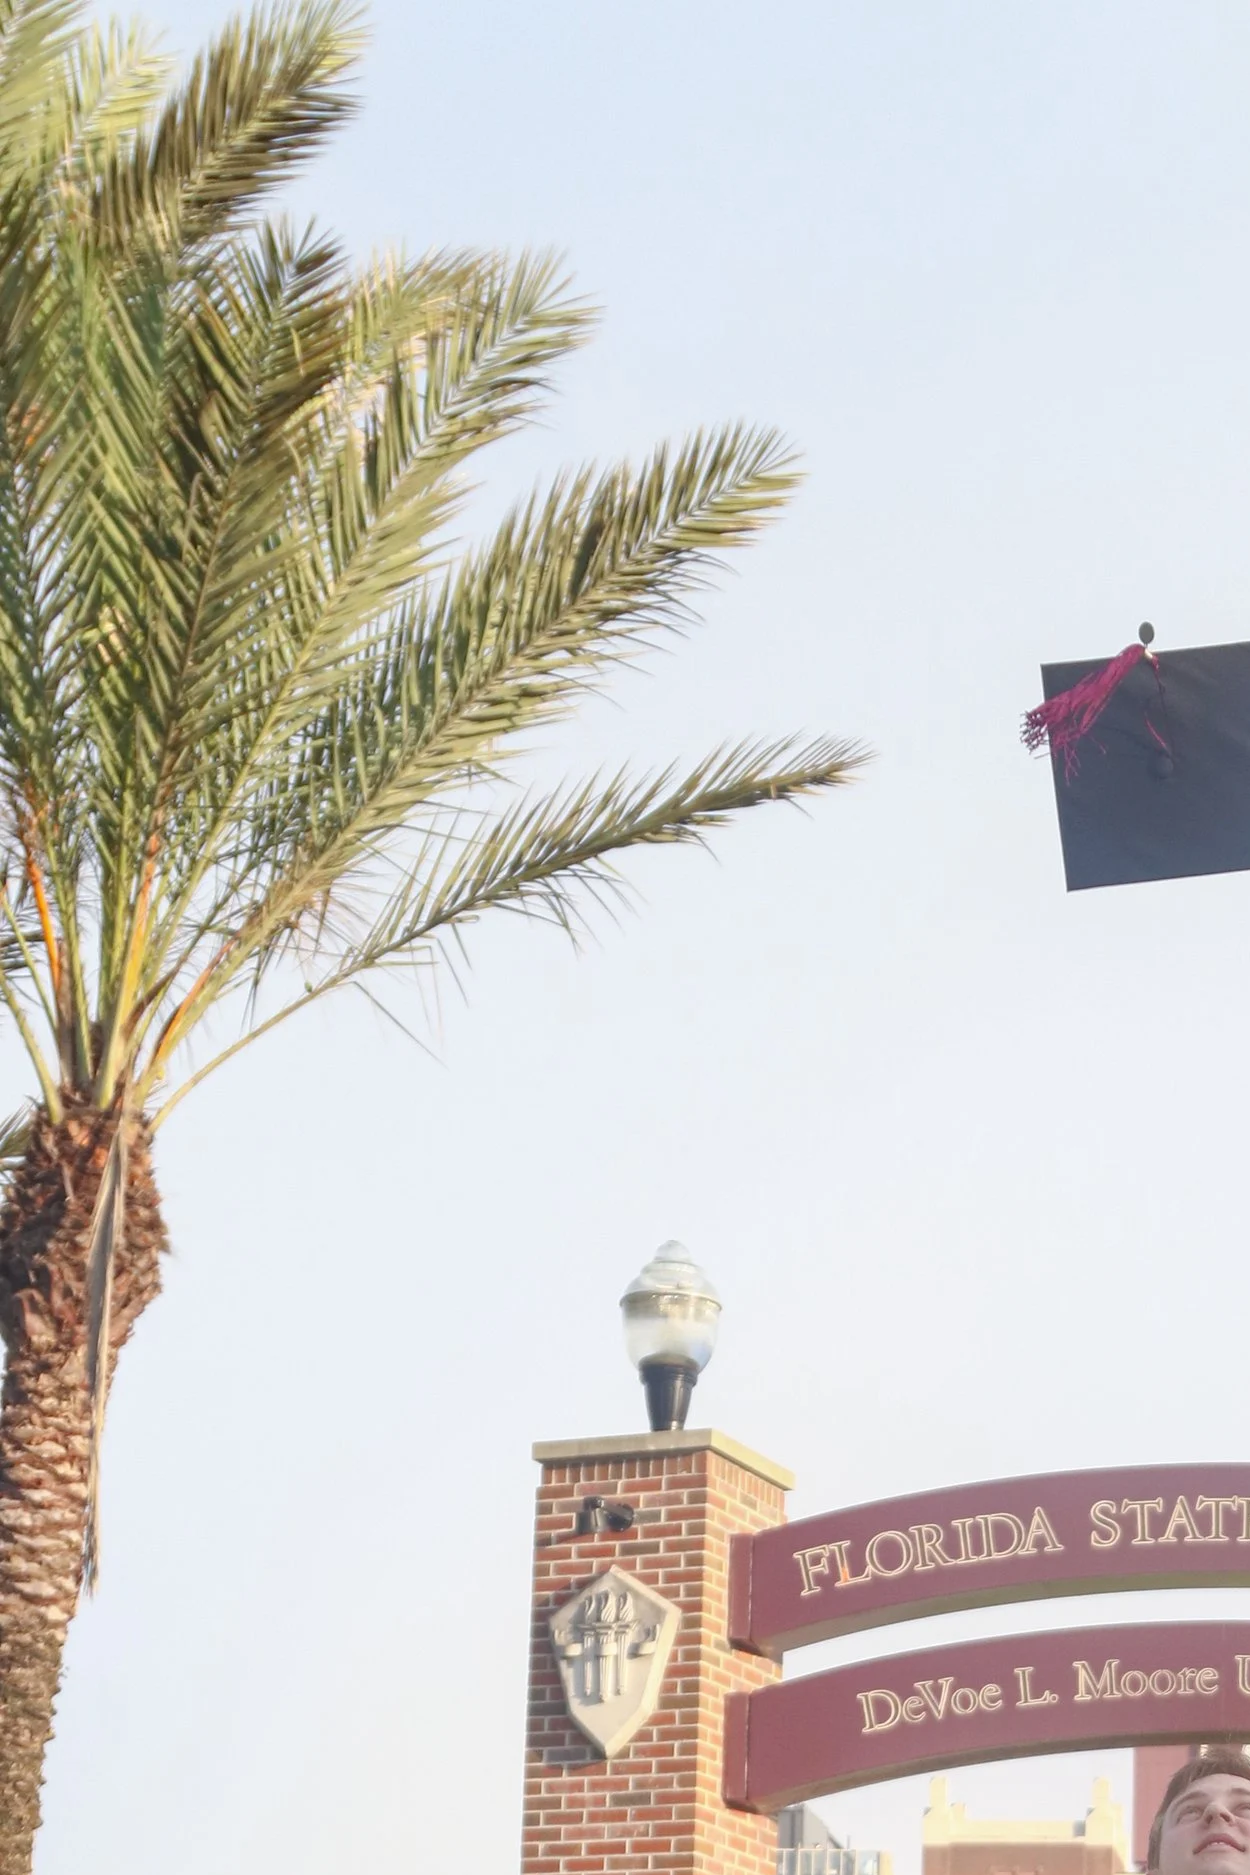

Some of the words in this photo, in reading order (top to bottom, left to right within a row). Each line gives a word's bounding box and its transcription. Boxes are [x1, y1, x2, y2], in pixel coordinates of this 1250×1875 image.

[793, 1506, 1063, 1597] FLORIDA
[857, 1676, 1003, 1733] DeVoe
[1014, 1666, 1059, 1707] L.
[1073, 1658, 1220, 1701] Moore
